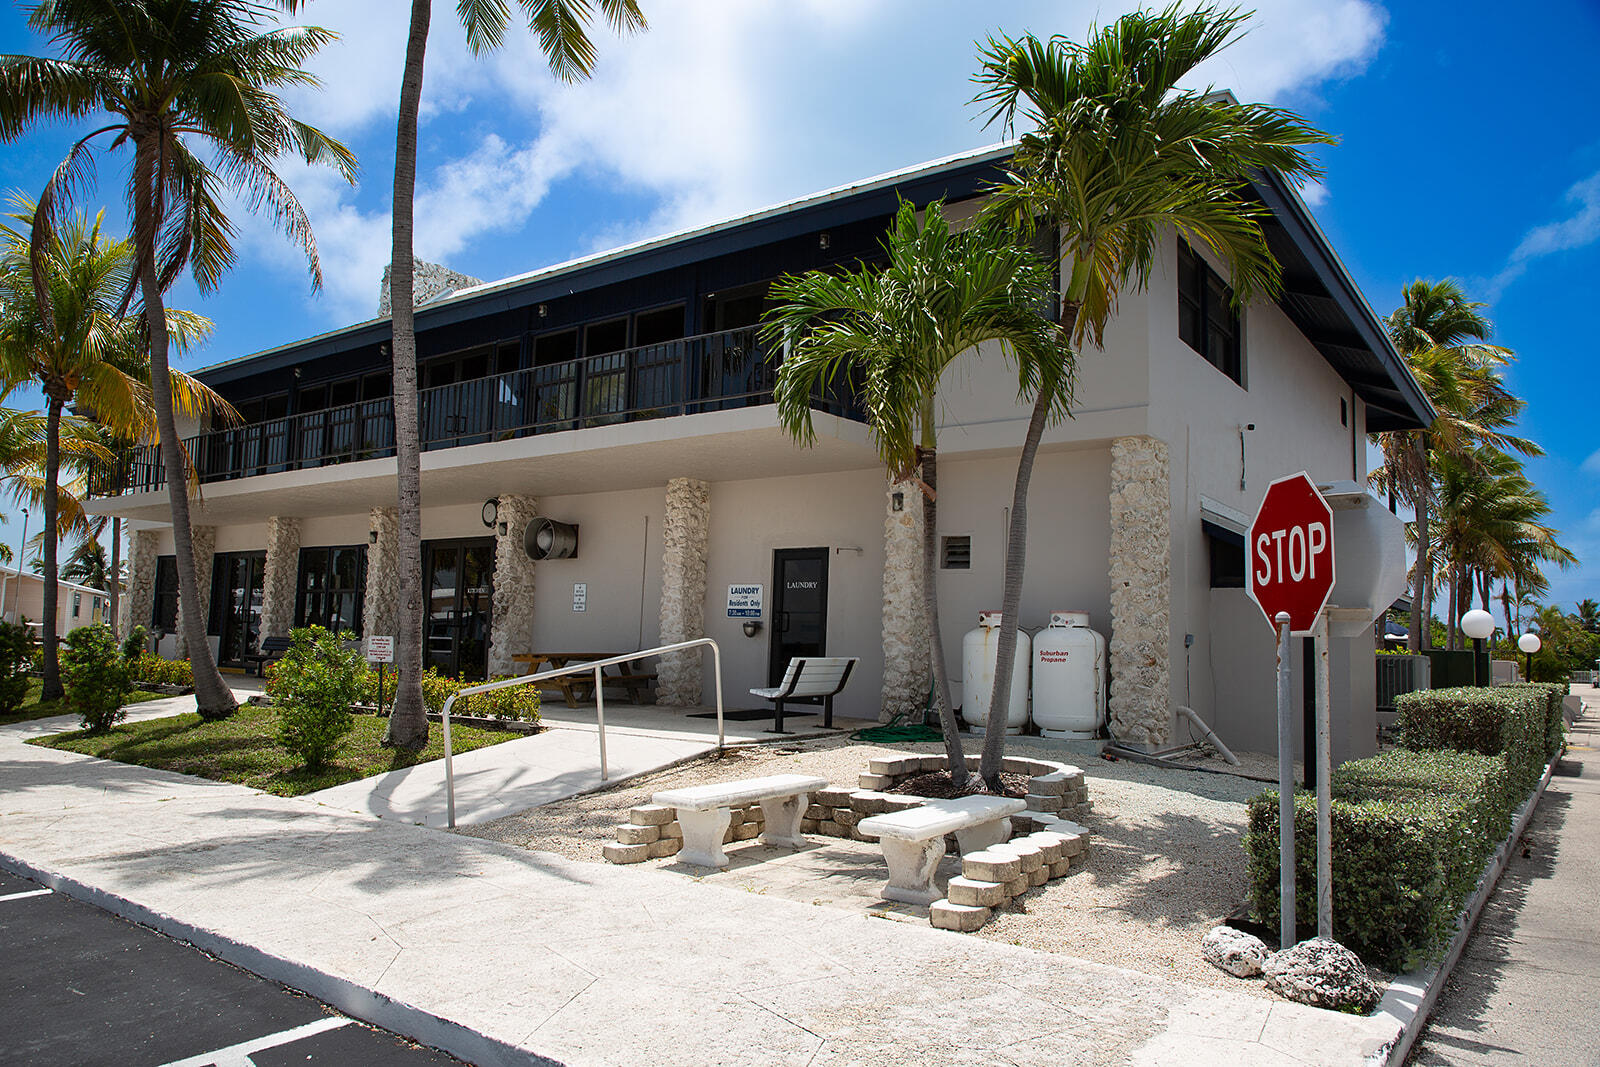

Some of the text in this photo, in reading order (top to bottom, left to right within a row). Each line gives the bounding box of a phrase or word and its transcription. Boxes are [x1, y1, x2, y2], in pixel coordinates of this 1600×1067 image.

[1256, 521, 1326, 587] STOP
[787, 581, 818, 589] LAUNDRY
[731, 587, 760, 595] LAUNDRY
[750, 600, 761, 608] Only
